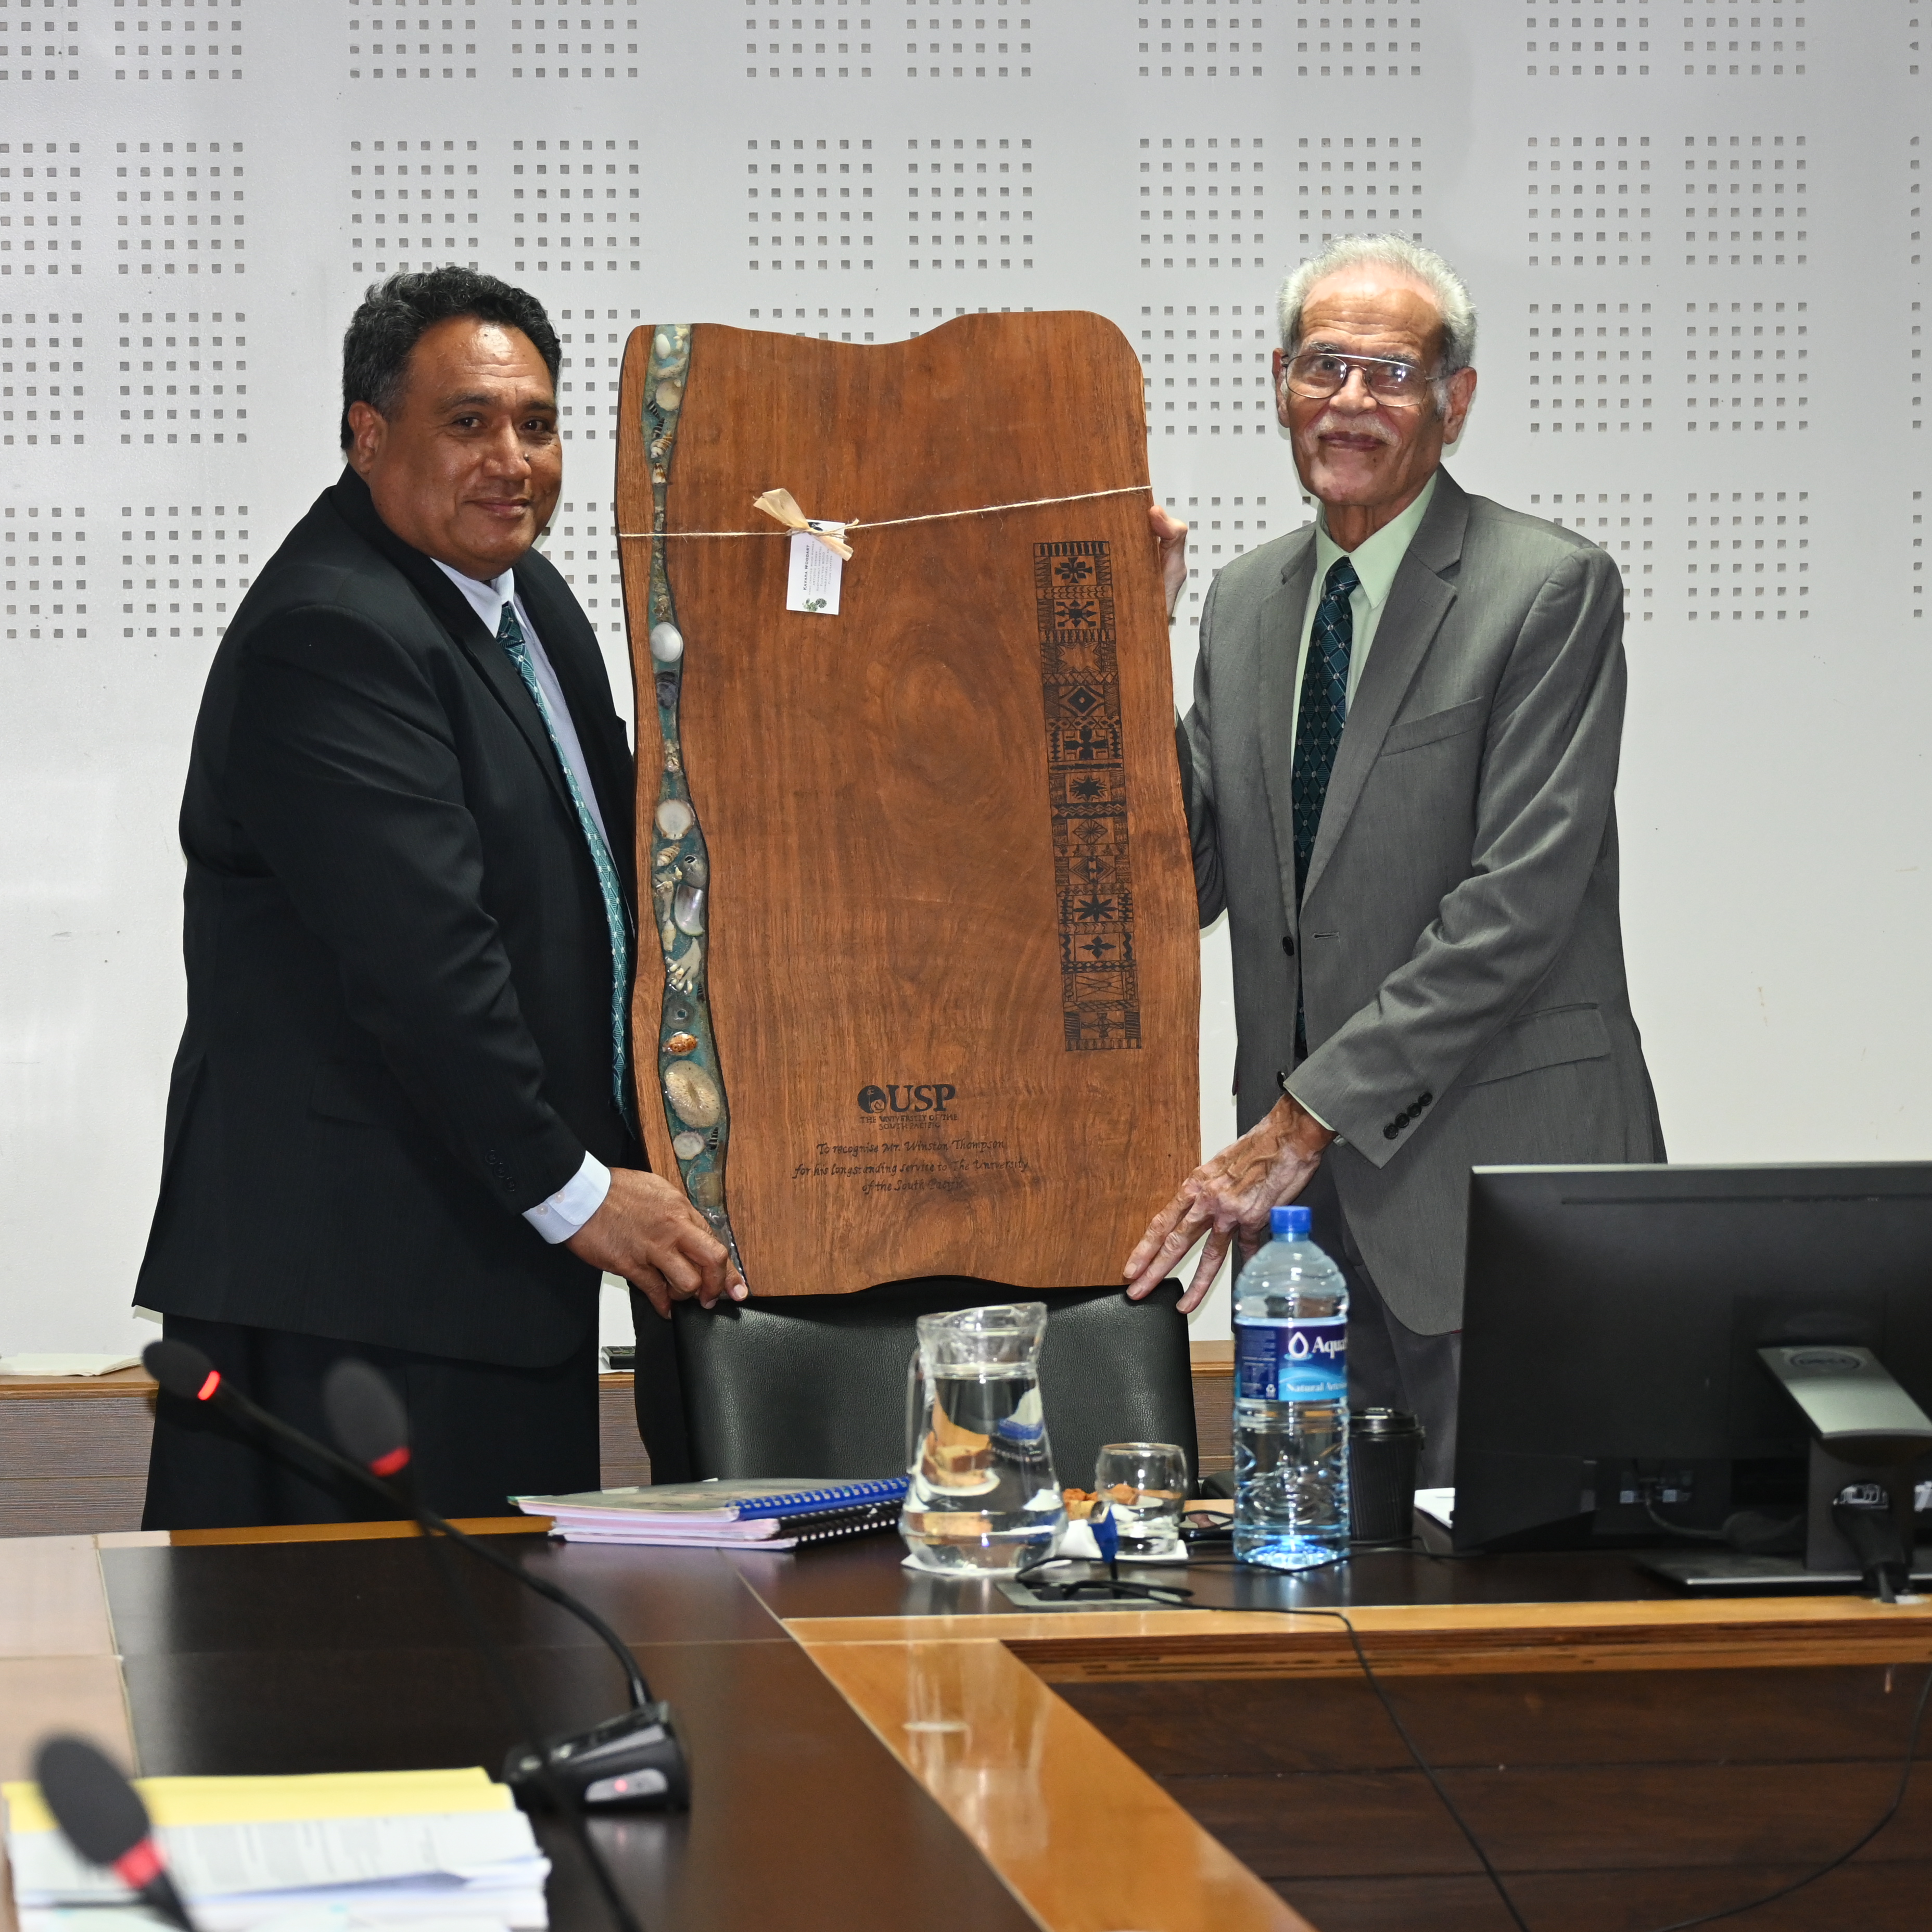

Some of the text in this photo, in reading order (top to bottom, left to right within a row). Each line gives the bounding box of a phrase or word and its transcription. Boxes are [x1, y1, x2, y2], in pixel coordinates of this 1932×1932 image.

[886, 1084, 956, 1112] USP
[817, 1138, 1004, 1157] To recognise Mr. Winston Thompson
[792, 1163, 811, 1179] for
[814, 1164, 829, 1176] his
[899, 1160, 934, 1172] service
[938, 1161, 947, 1171] to
[862, 1179, 874, 1194] of
[874, 1180, 892, 1191] the
[894, 1178, 924, 1191] South
[1286, 1382, 1325, 1392] Natural
